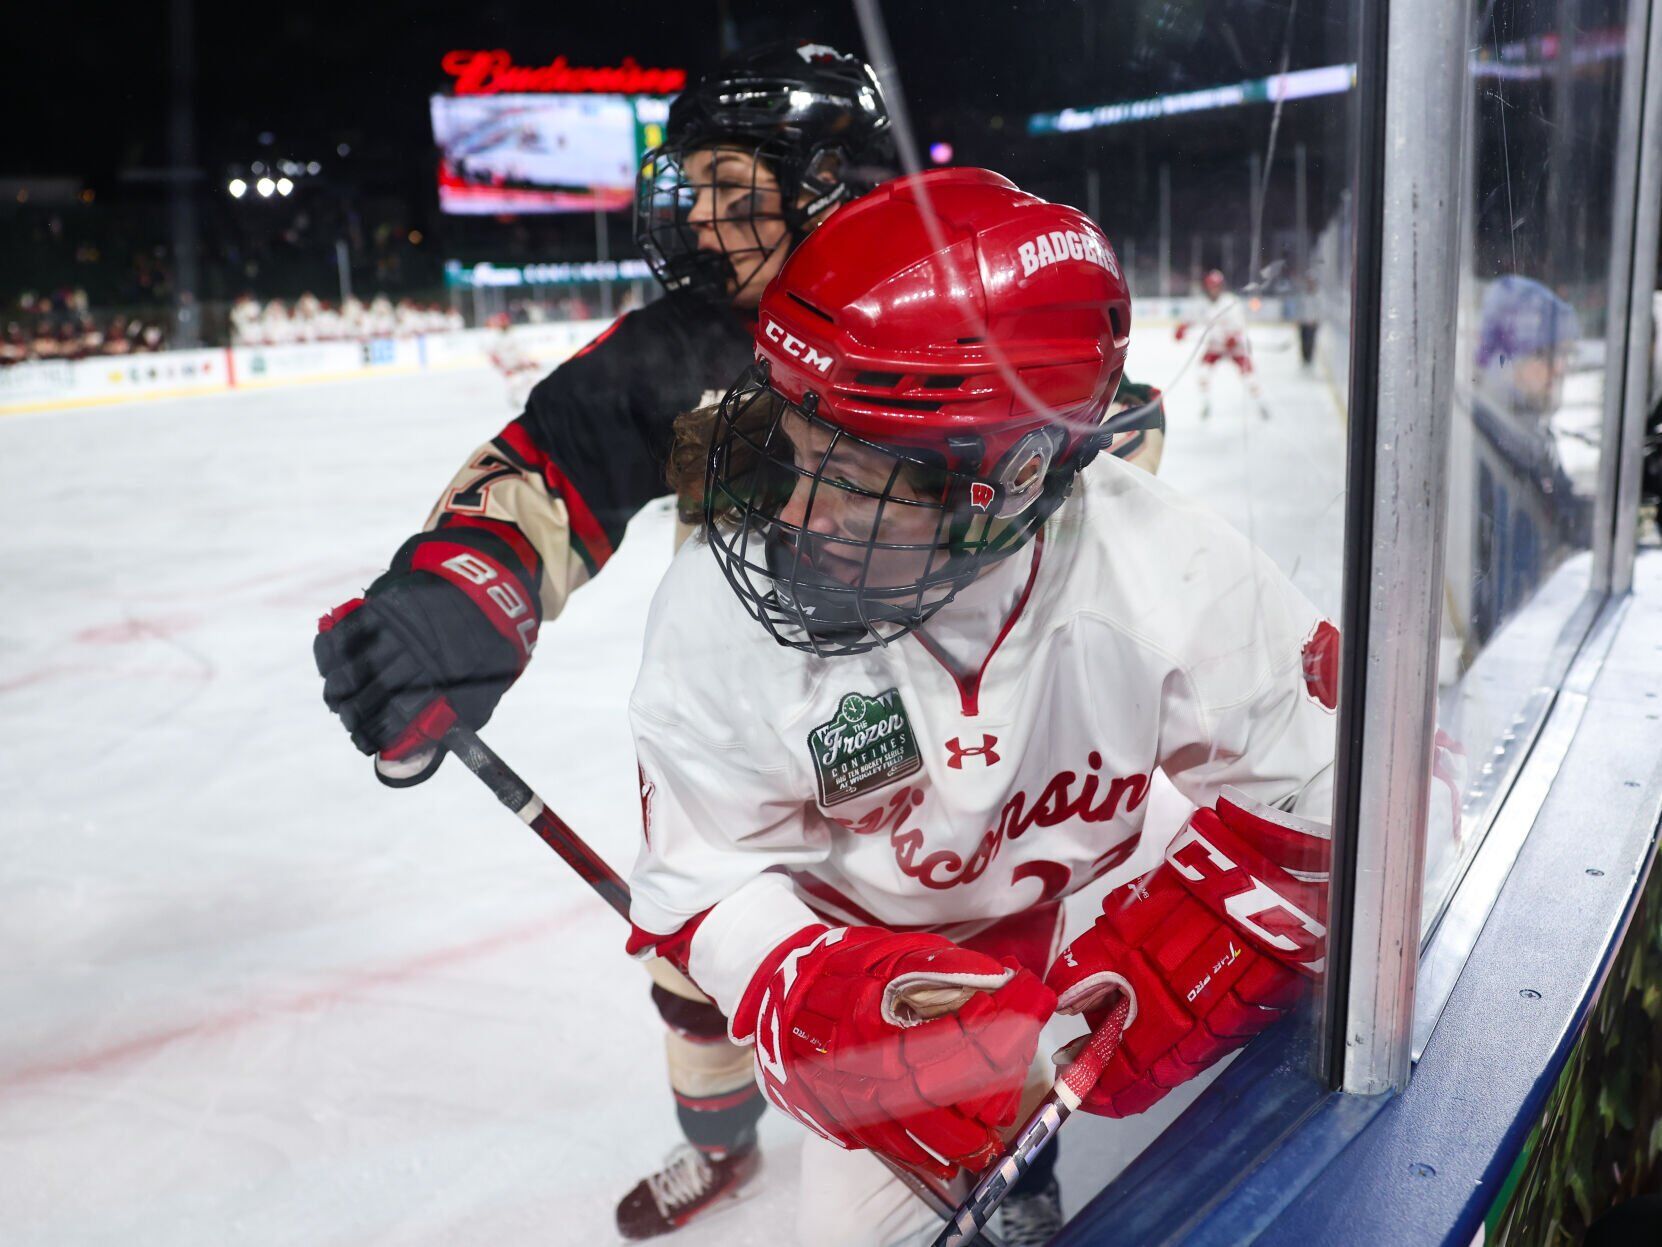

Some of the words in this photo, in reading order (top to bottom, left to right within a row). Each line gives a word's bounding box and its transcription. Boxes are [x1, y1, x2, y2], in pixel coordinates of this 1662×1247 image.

[1018, 230, 1120, 279] BADGERS
[765, 319, 835, 373] CCM
[445, 452, 528, 514] 7
[822, 713, 905, 766] Frozen
[852, 721, 868, 733] THE
[831, 733, 906, 778] CONFINES
[848, 768, 860, 779] TEN
[860, 756, 883, 773] HOCKEY
[884, 746, 905, 762] SERIES
[850, 766, 882, 786] WRIGLEY
[1187, 973, 1211, 1002] PRO
